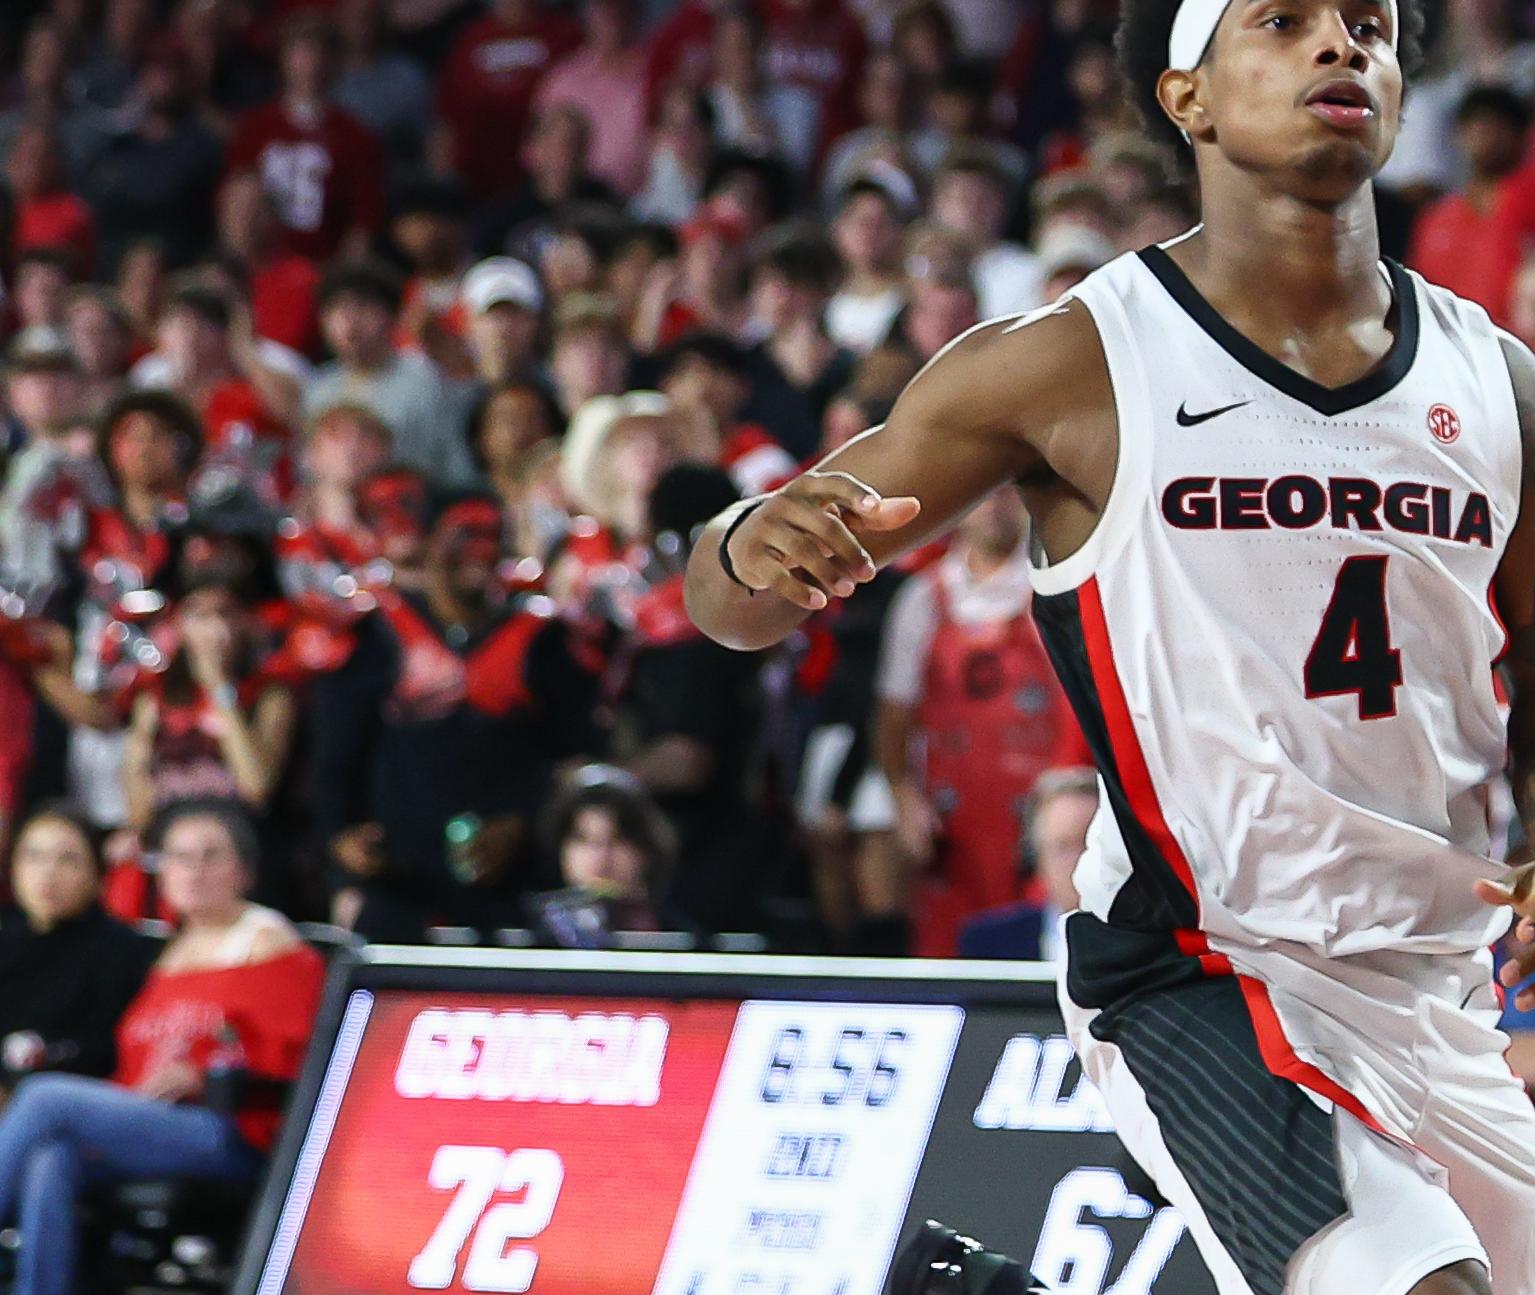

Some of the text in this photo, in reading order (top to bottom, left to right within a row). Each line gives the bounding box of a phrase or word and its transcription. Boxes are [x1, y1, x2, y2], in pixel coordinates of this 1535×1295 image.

[1430, 407, 1458, 440] SEC
[1161, 474, 1494, 549] GEORGIA
[1304, 554, 1403, 721] 4
[406, 1145, 566, 1293] 72
